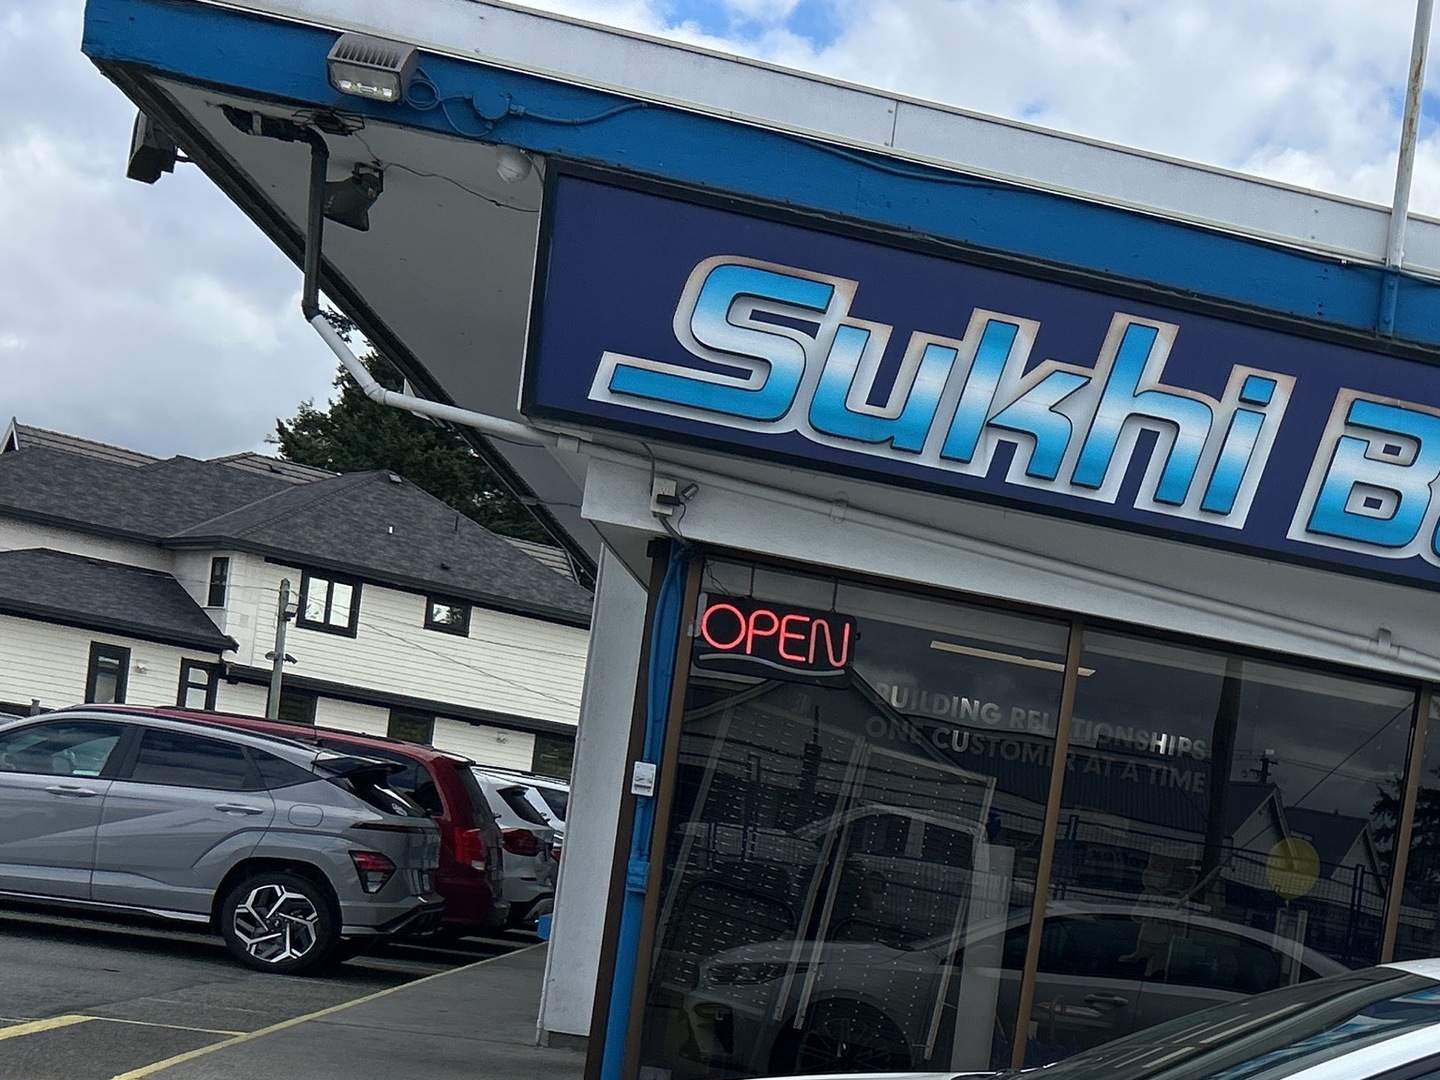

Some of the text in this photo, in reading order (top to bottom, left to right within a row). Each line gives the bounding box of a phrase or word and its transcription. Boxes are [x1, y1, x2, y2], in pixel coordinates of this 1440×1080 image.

[588, 255, 1297, 529] Sukhi
[701, 603, 850, 668] OPEN
[875, 682, 1207, 761] BUILDING RELTIONSHIPS
[1083, 753, 1117, 778] AT
[1121, 760, 1140, 782] A
[1147, 763, 1207, 793] TIME
